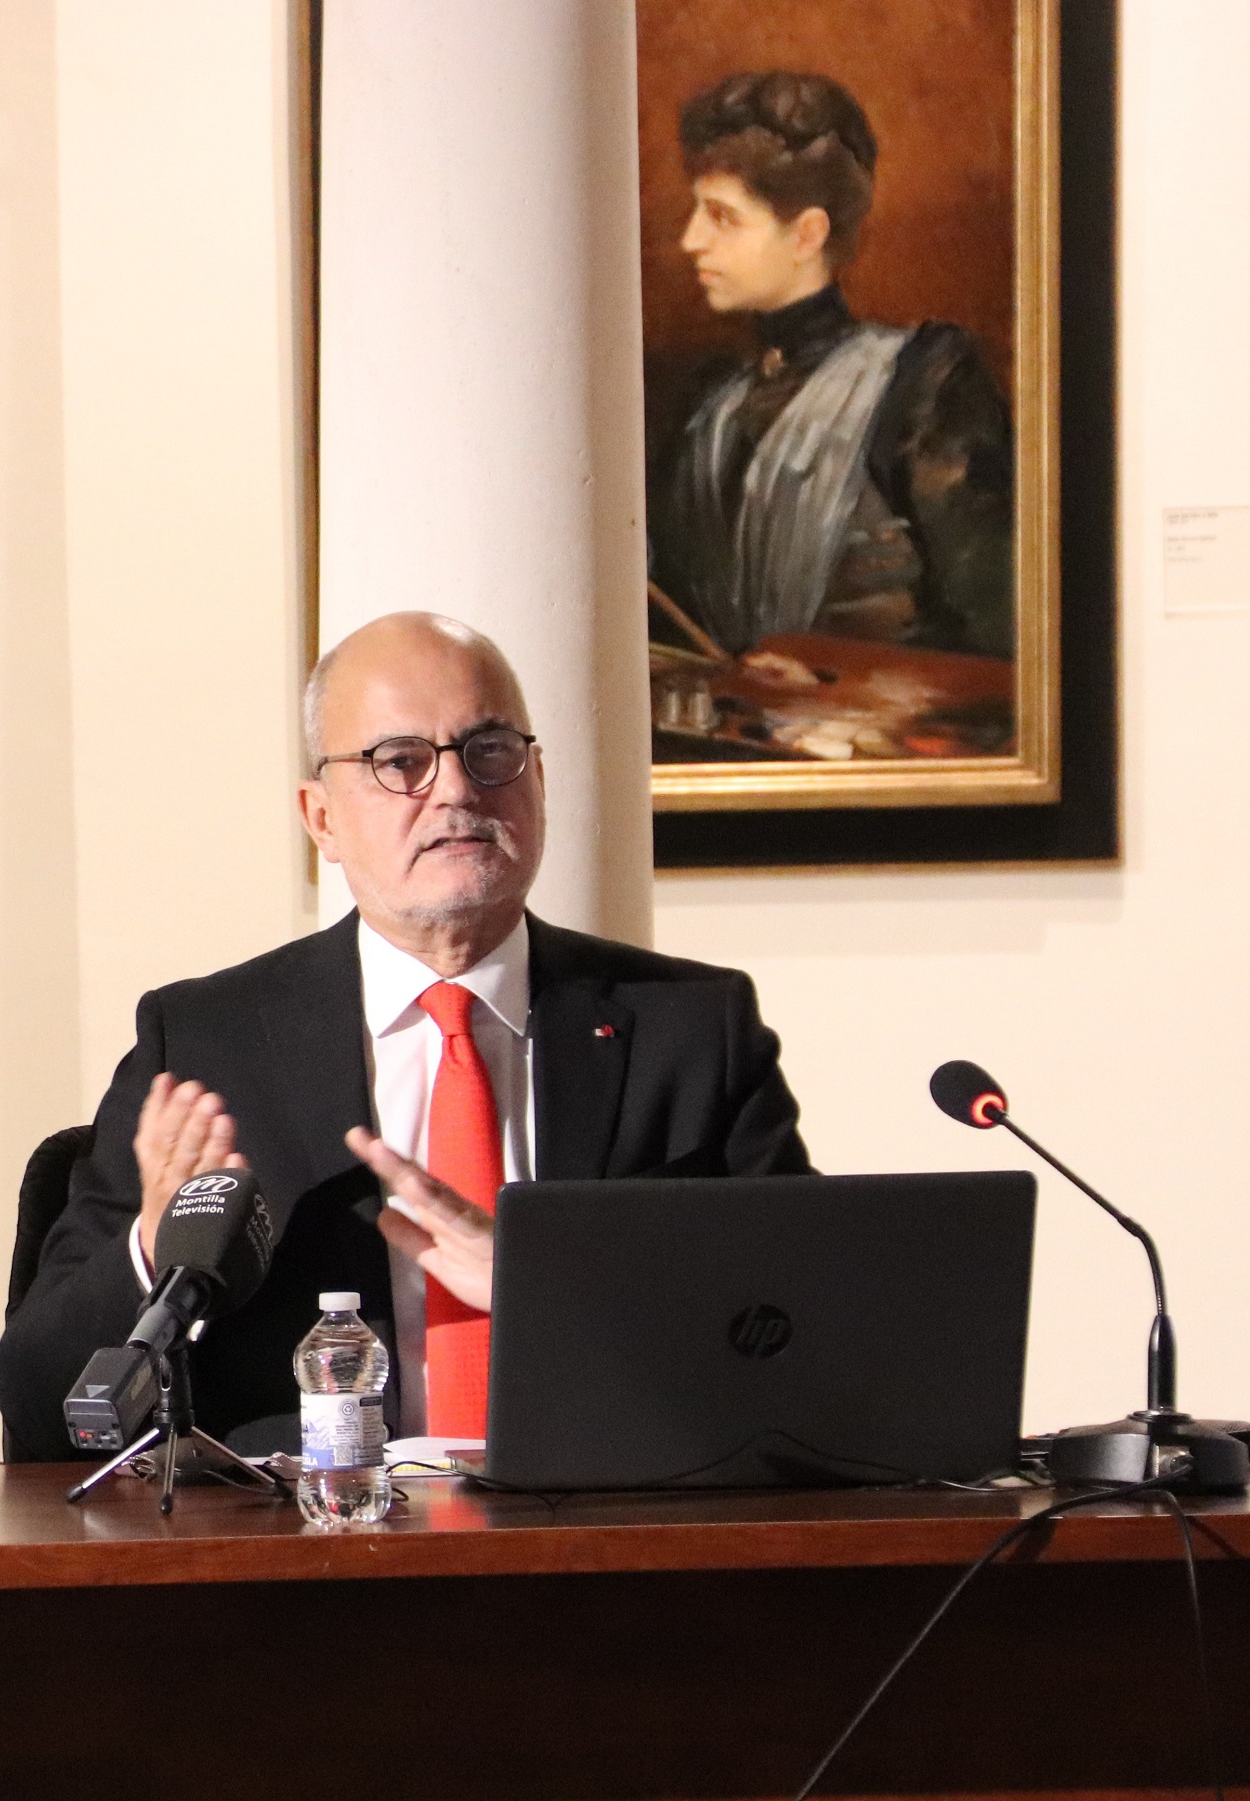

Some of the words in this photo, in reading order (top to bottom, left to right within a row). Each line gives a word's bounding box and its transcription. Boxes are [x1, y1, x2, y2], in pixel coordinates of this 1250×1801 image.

[175, 1195, 225, 1207] Montilla
[172, 1205, 224, 1218] Televisión
[732, 1304, 790, 1359] hp
